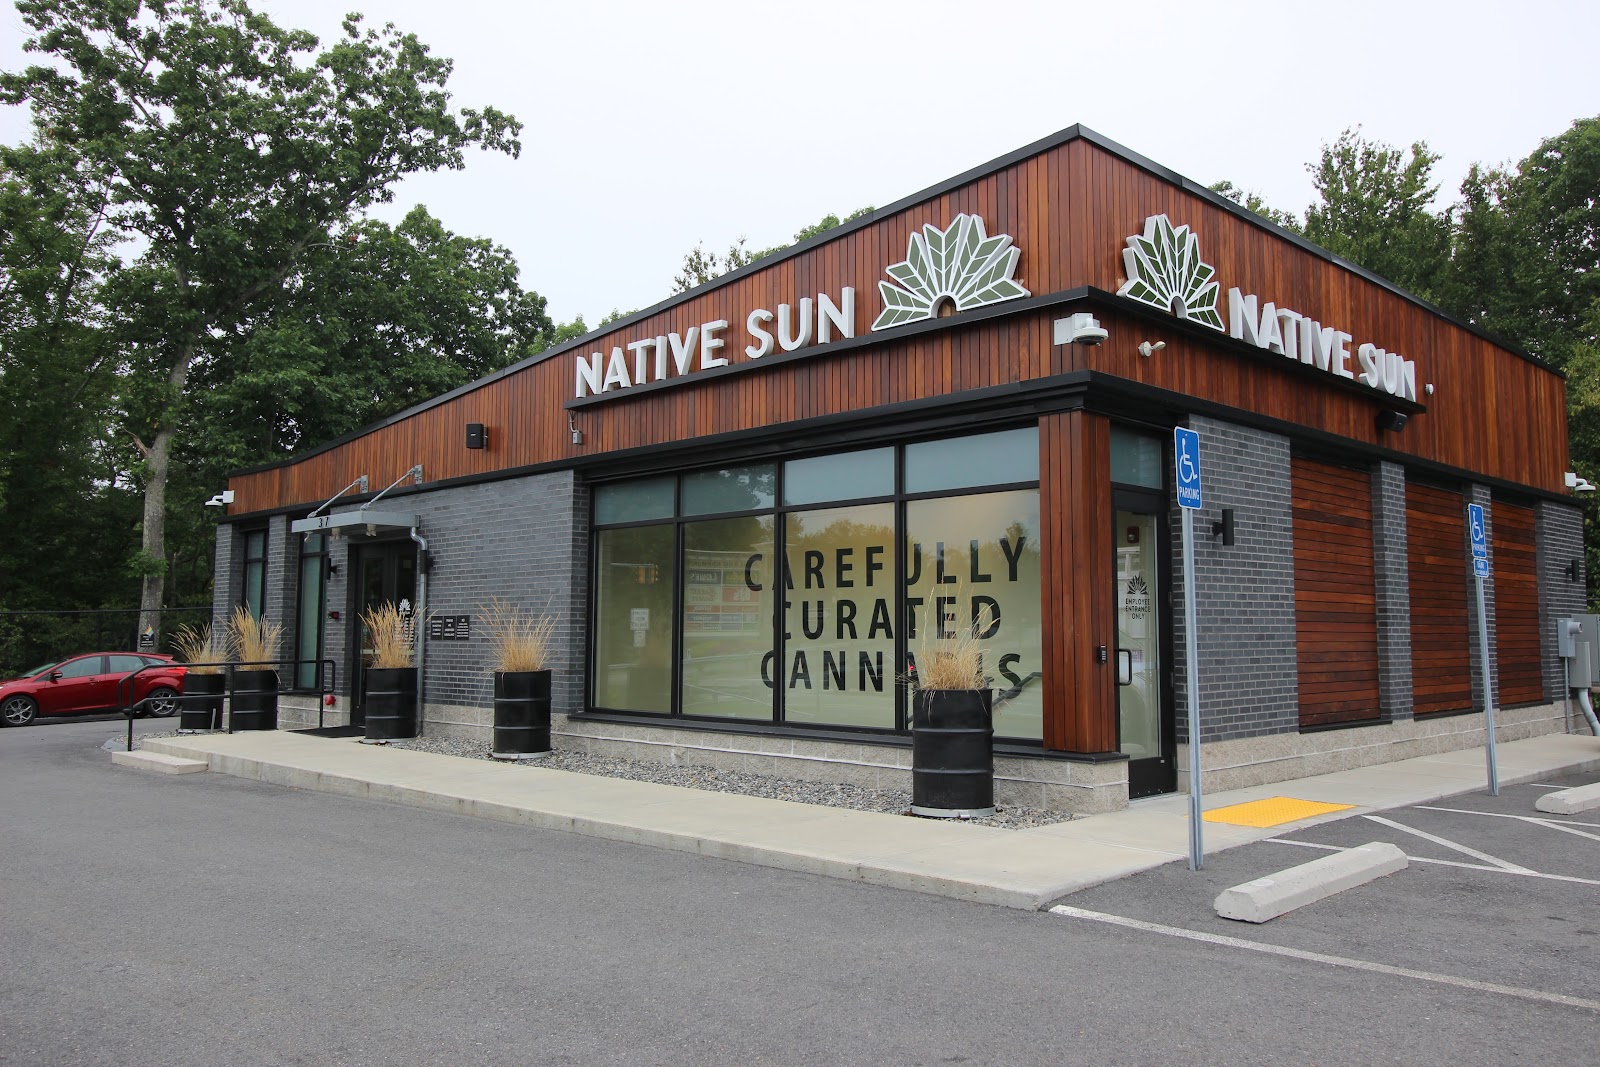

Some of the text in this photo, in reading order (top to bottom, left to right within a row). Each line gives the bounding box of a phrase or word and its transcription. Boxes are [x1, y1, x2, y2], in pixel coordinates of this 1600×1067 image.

[576, 286, 855, 398] NATIVE SUN
[1228, 287, 1416, 402] NATIVE SUN
[1179, 486, 1199, 500] PARKING
[318, 516, 330, 528] 37
[744, 537, 1027, 591] CAREFULLY
[772, 595, 1002, 640] CURATED
[1125, 605, 1151, 613] ENTRANCE
[1131, 612, 1146, 620] ONLY
